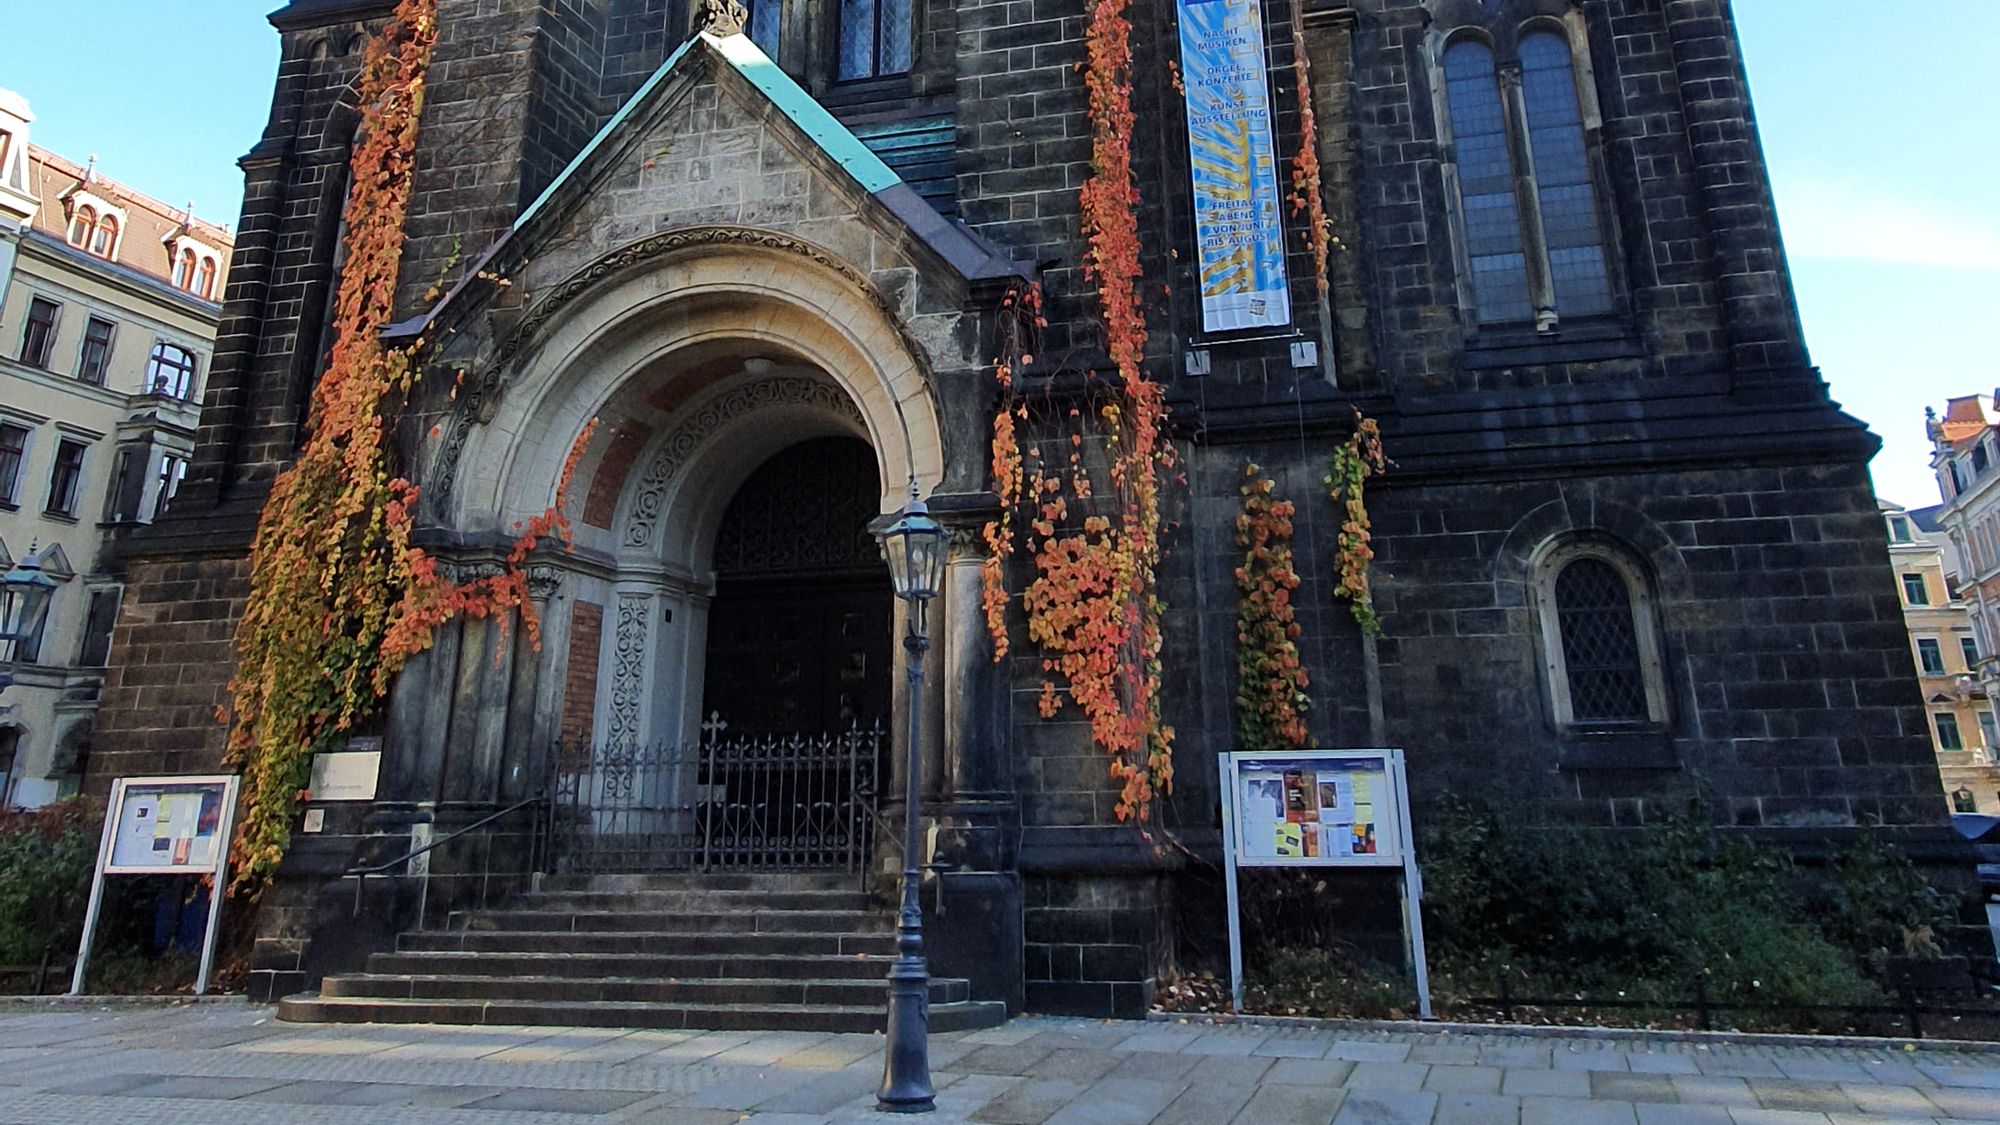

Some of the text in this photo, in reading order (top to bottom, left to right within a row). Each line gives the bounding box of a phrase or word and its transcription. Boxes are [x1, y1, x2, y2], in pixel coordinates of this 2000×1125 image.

[1203, 27, 1238, 38] NACHT
[1198, 38, 1246, 50] MUSIKEN
[1197, 73, 1252, 87] KONZERTE
[1210, 101, 1245, 111] KUNST
[1191, 109, 1266, 125] AUSSTELLUNG
[1212, 199, 1256, 210] FREITAG
[1218, 210, 1256, 221] ABEND
[1212, 220, 1264, 233] VON JUNI
[1207, 232, 1270, 247] BIS AUGUST
